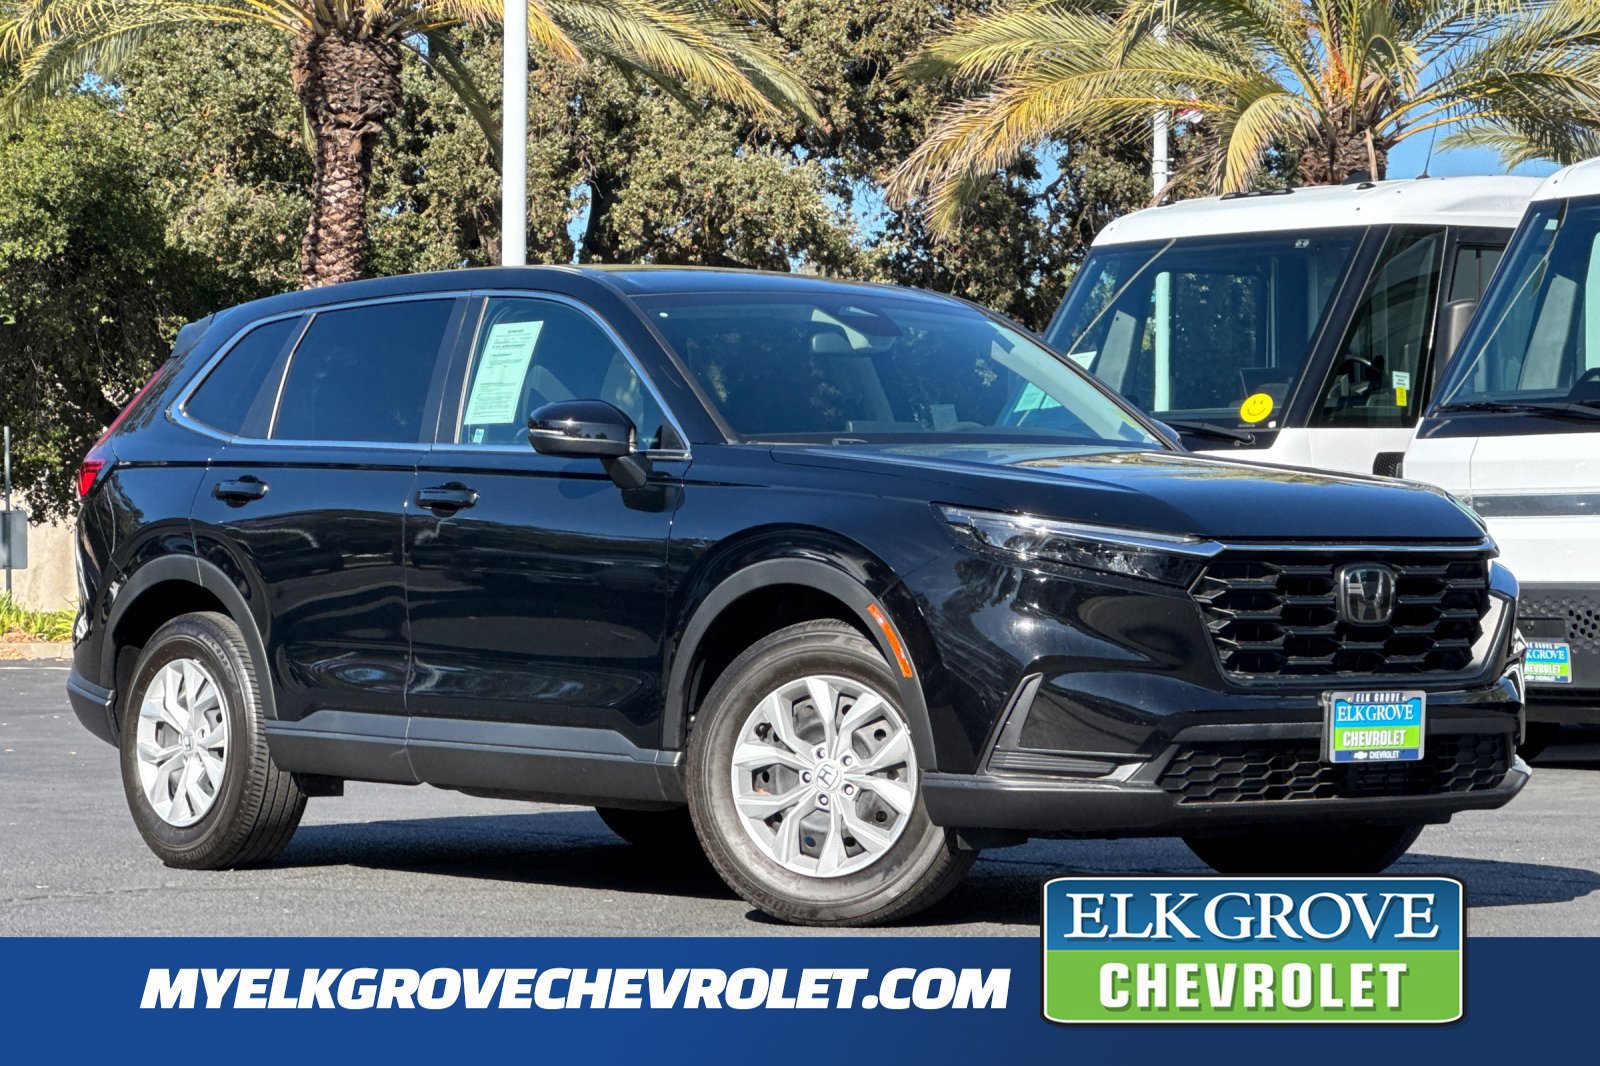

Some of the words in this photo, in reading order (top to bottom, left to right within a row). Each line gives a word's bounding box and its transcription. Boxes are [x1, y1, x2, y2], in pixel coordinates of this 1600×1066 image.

[1532, 650, 1565, 660] GROVE
[1355, 693, 1371, 702] ELK
[1374, 692, 1401, 702] GROVE
[1337, 705, 1365, 721] ELK
[1365, 704, 1414, 720] GROVE
[1343, 730, 1406, 747] CHEVROLET
[1369, 751, 1399, 759] CHEVROLET
